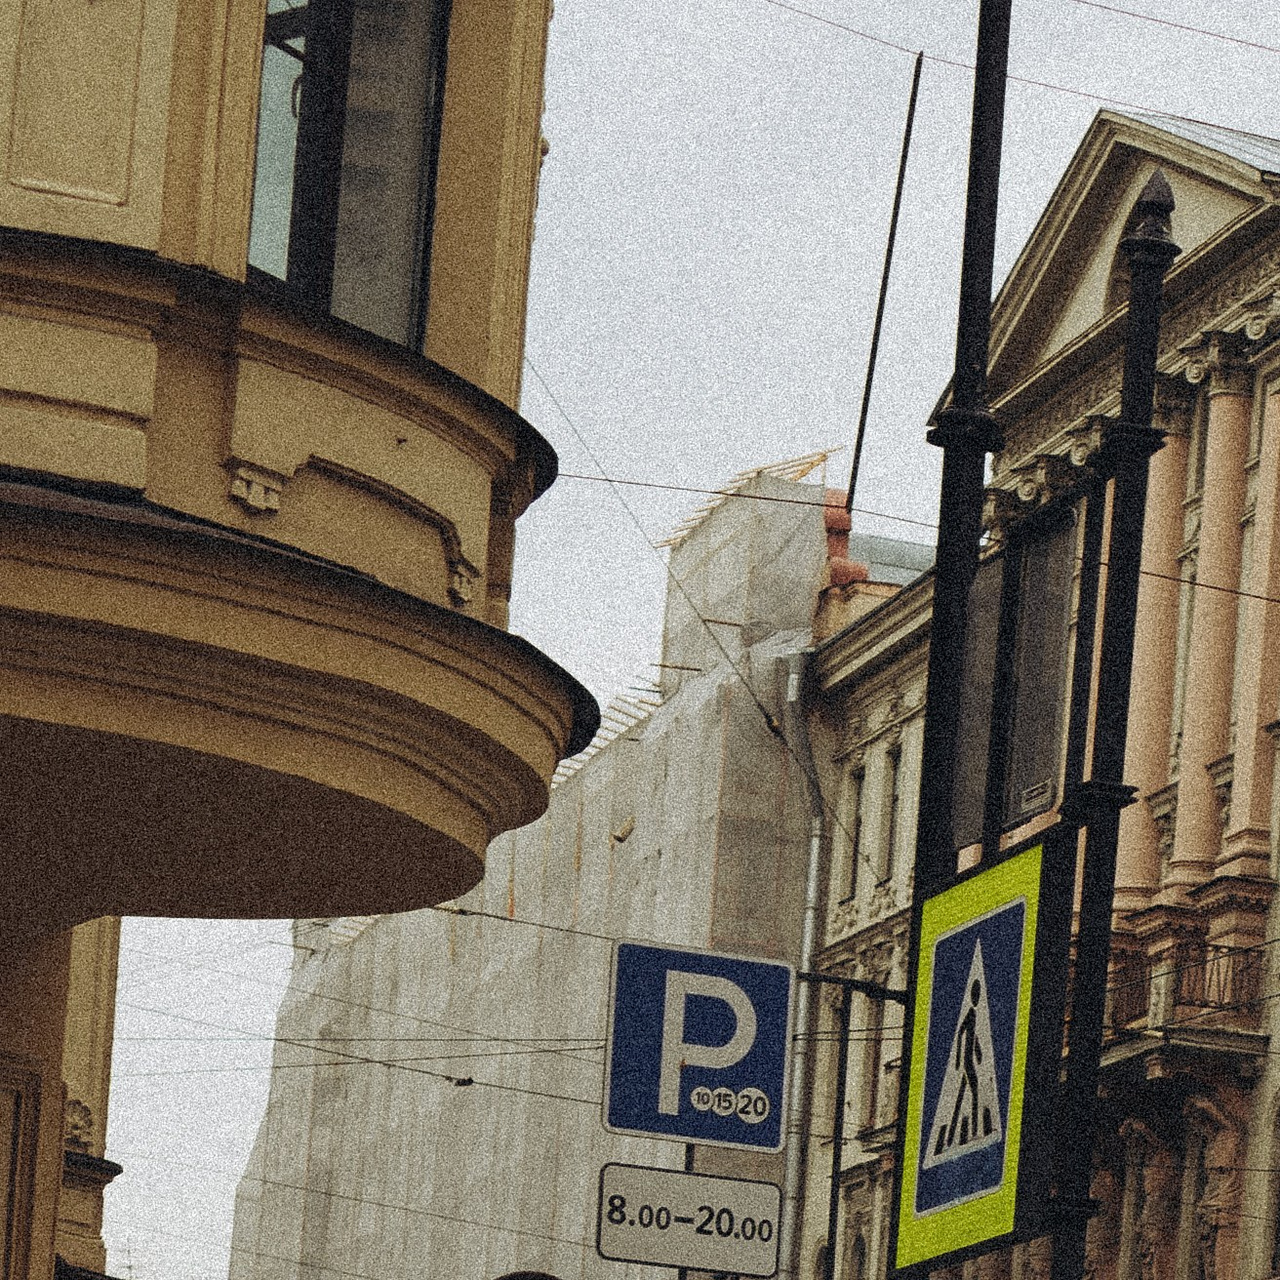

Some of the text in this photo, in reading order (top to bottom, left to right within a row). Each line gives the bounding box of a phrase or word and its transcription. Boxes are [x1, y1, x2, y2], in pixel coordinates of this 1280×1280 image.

[658, 969, 758, 1116] P
[695, 1092, 767, 1116] 10 15 20
[607, 1194, 773, 1242] 8.00-20.00
